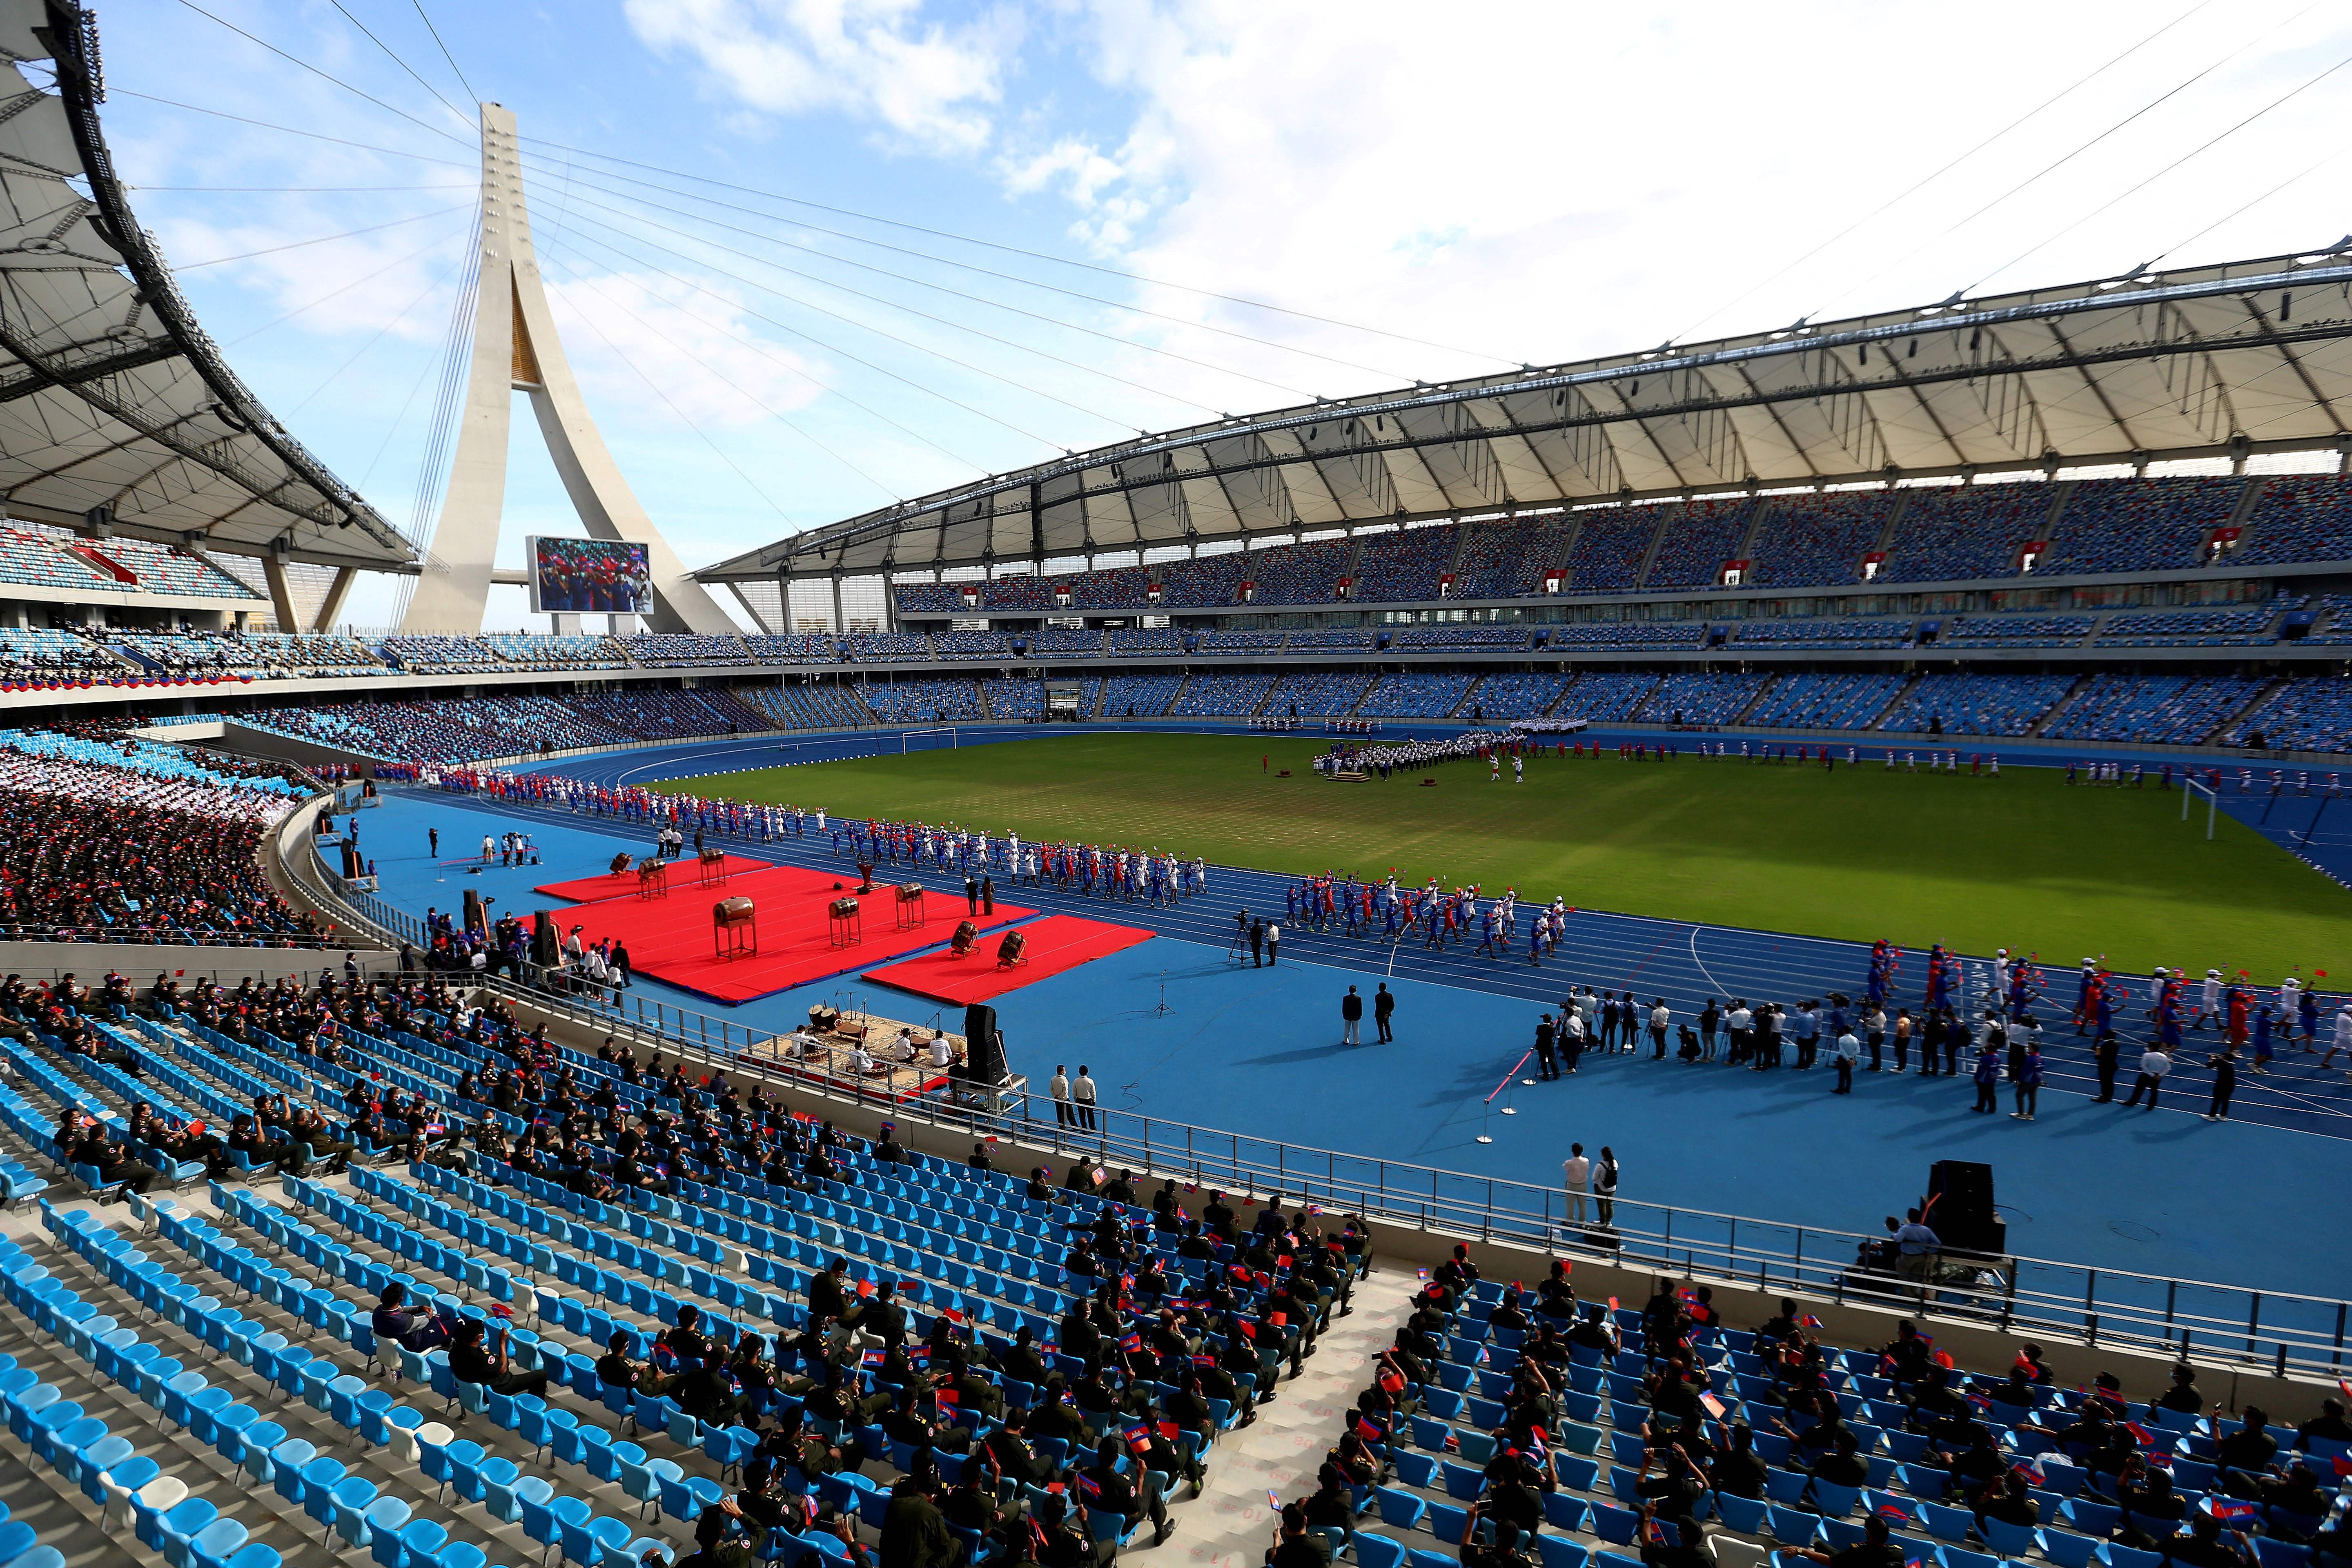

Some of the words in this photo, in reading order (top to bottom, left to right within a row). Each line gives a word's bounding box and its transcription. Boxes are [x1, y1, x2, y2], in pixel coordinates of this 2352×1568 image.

[1971, 980, 1990, 989] 3
[1349, 1356, 1367, 1366] 05
[1333, 1380, 1351, 1390] 06
[1313, 1406, 1334, 1418] 07
[1293, 1436, 1314, 1449] 08
[1269, 1468, 1291, 1483] 09
[1243, 1507, 1262, 1523] 10
[1210, 1552, 1232, 1568] 11
